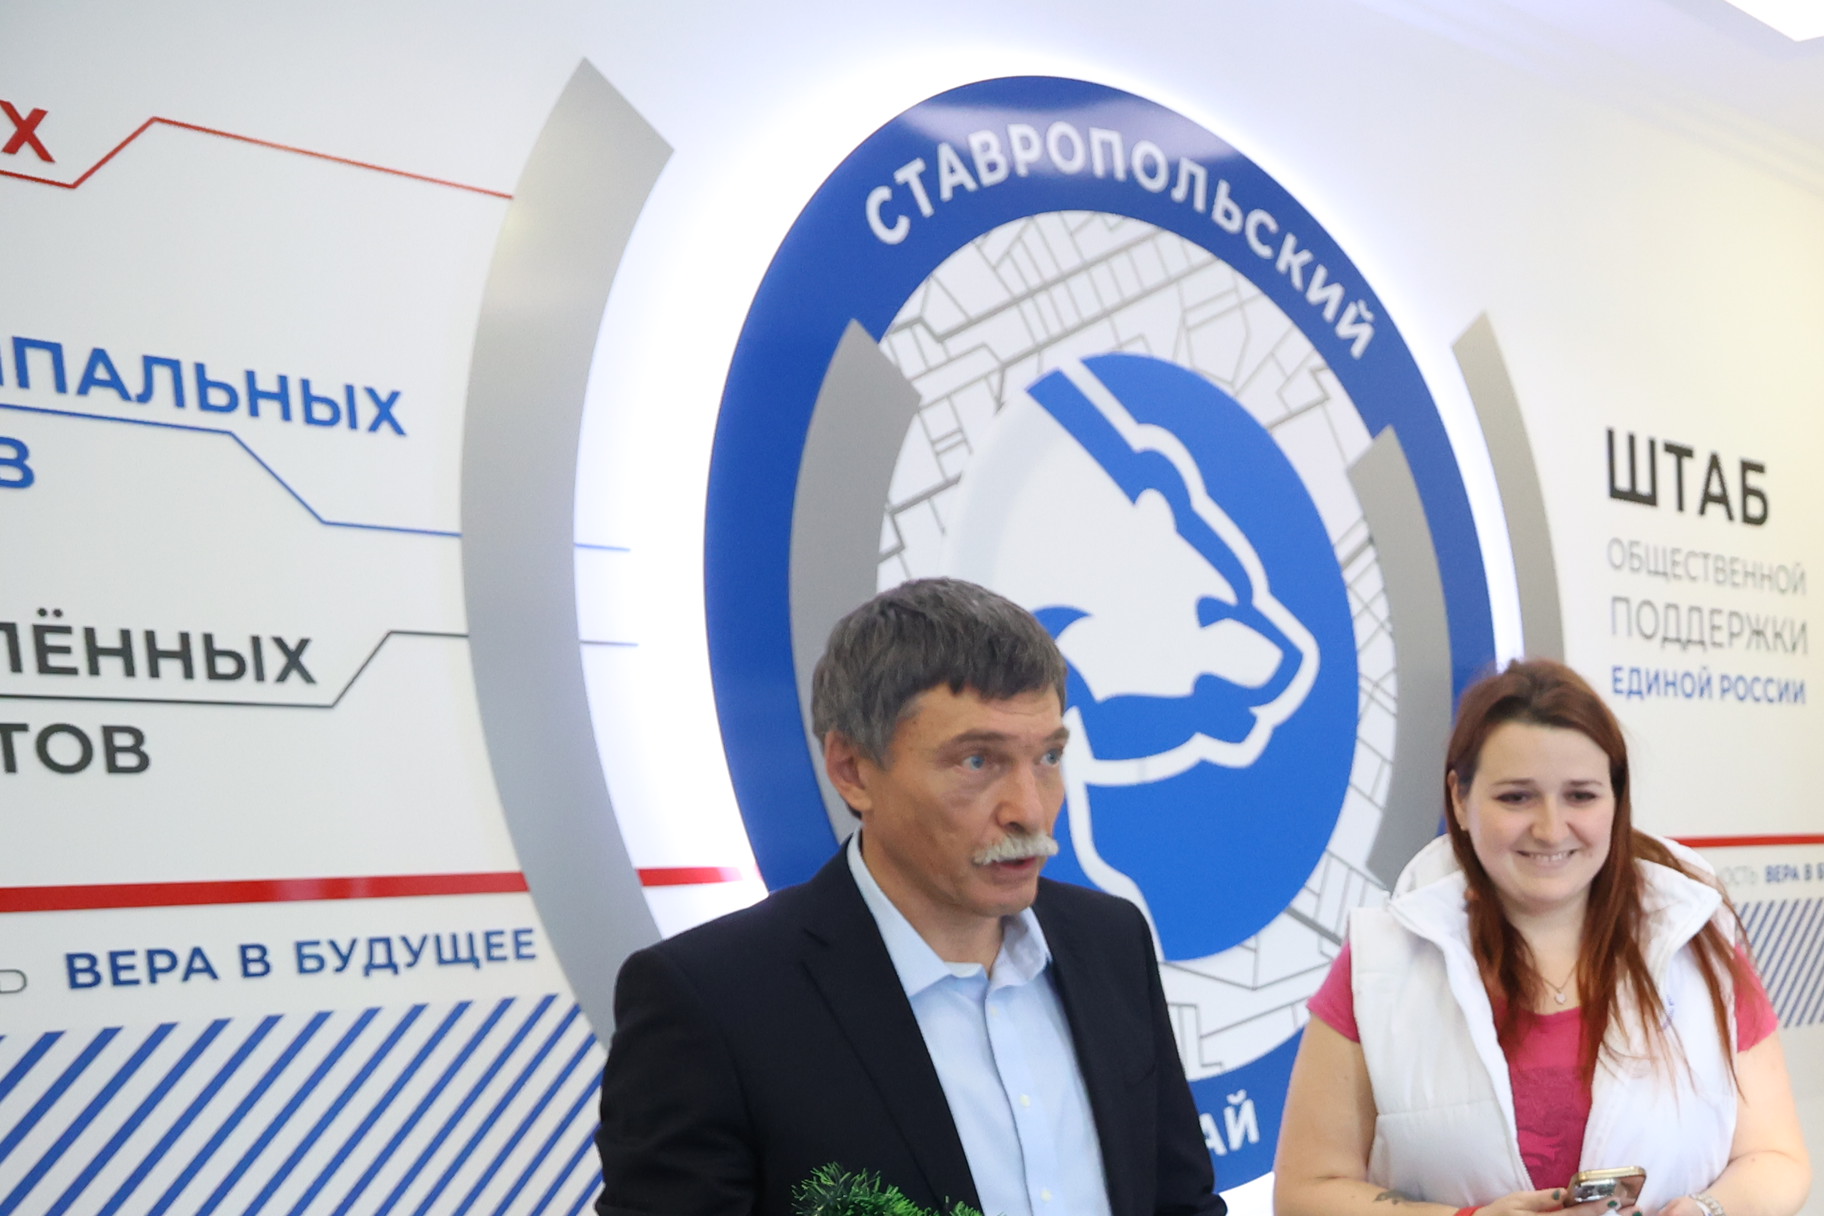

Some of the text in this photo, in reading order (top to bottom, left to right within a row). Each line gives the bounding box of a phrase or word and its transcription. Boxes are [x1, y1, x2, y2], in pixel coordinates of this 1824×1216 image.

[865, 121, 1377, 360] СТАВРОПОЛЬСКИЙ
[0, 335, 407, 437] ПАЛЬНЫХ
[1606, 427, 1769, 526] ШТАБ
[1607, 537, 1807, 595] ОБЩЕСТВЕННОЙ
[1611, 596, 1808, 655] ПОДДЕРЖКИ
[1612, 666, 1807, 704] ЕДИНОЙ РОССИИ
[0, 723, 151, 774] ТОВ
[65, 948, 219, 990] ВЕРА
[239, 943, 272, 978] В
[294, 928, 538, 977] БУДУЩЕЕ
